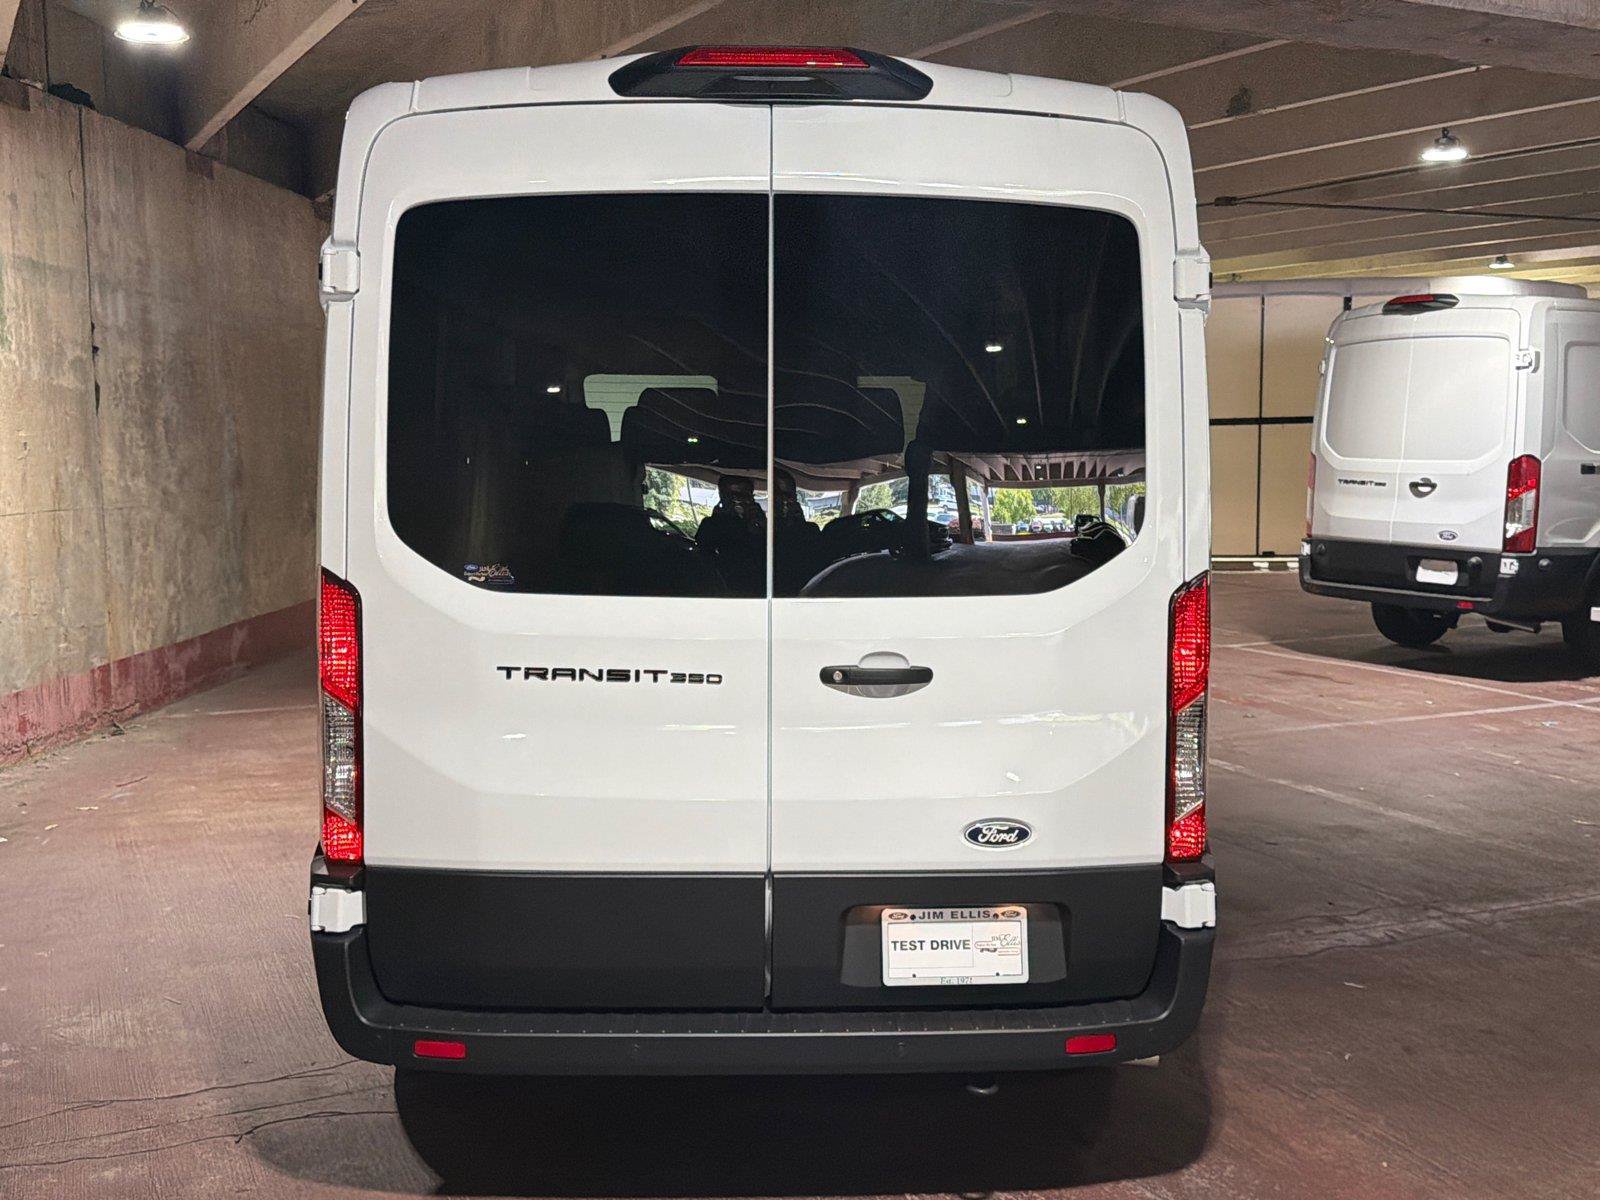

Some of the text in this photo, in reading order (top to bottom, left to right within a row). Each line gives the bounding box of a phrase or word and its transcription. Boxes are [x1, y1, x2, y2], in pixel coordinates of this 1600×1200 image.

[497, 666, 723, 684] TRANSIT 350
[977, 825, 1020, 843] Ford
[918, 910, 990, 920] JIM ELLIS
[891, 939, 971, 951] TEST DRIVE
